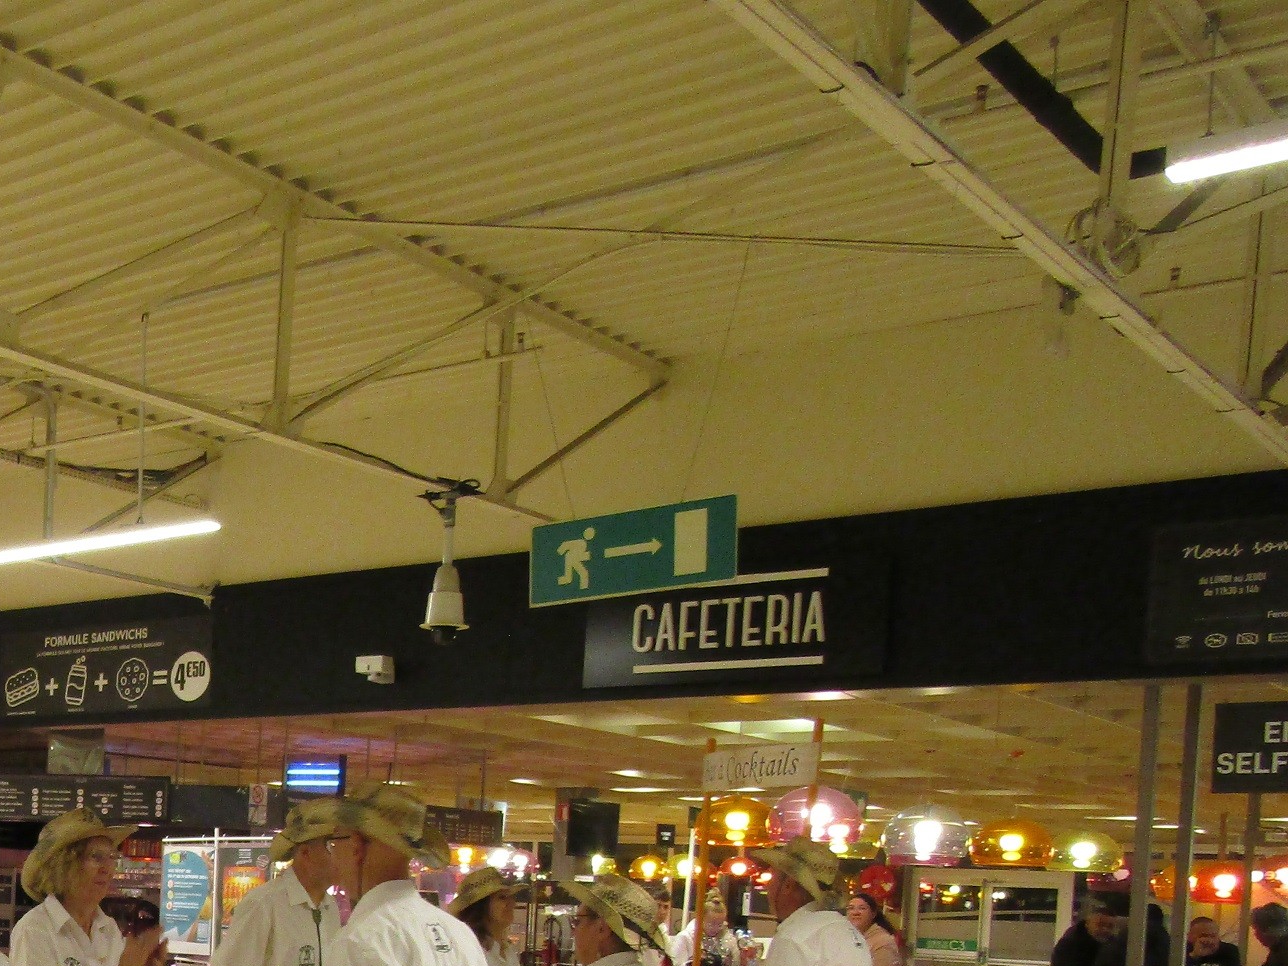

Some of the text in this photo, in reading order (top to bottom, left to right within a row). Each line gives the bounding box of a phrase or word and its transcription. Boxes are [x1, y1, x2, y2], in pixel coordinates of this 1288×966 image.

[632, 590, 826, 653] CAFETERIA
[44, 627, 149, 648] FORMULE SANDWICHS
[726, 747, 800, 784] Cocktails
[1216, 751, 1288, 775] SELF
